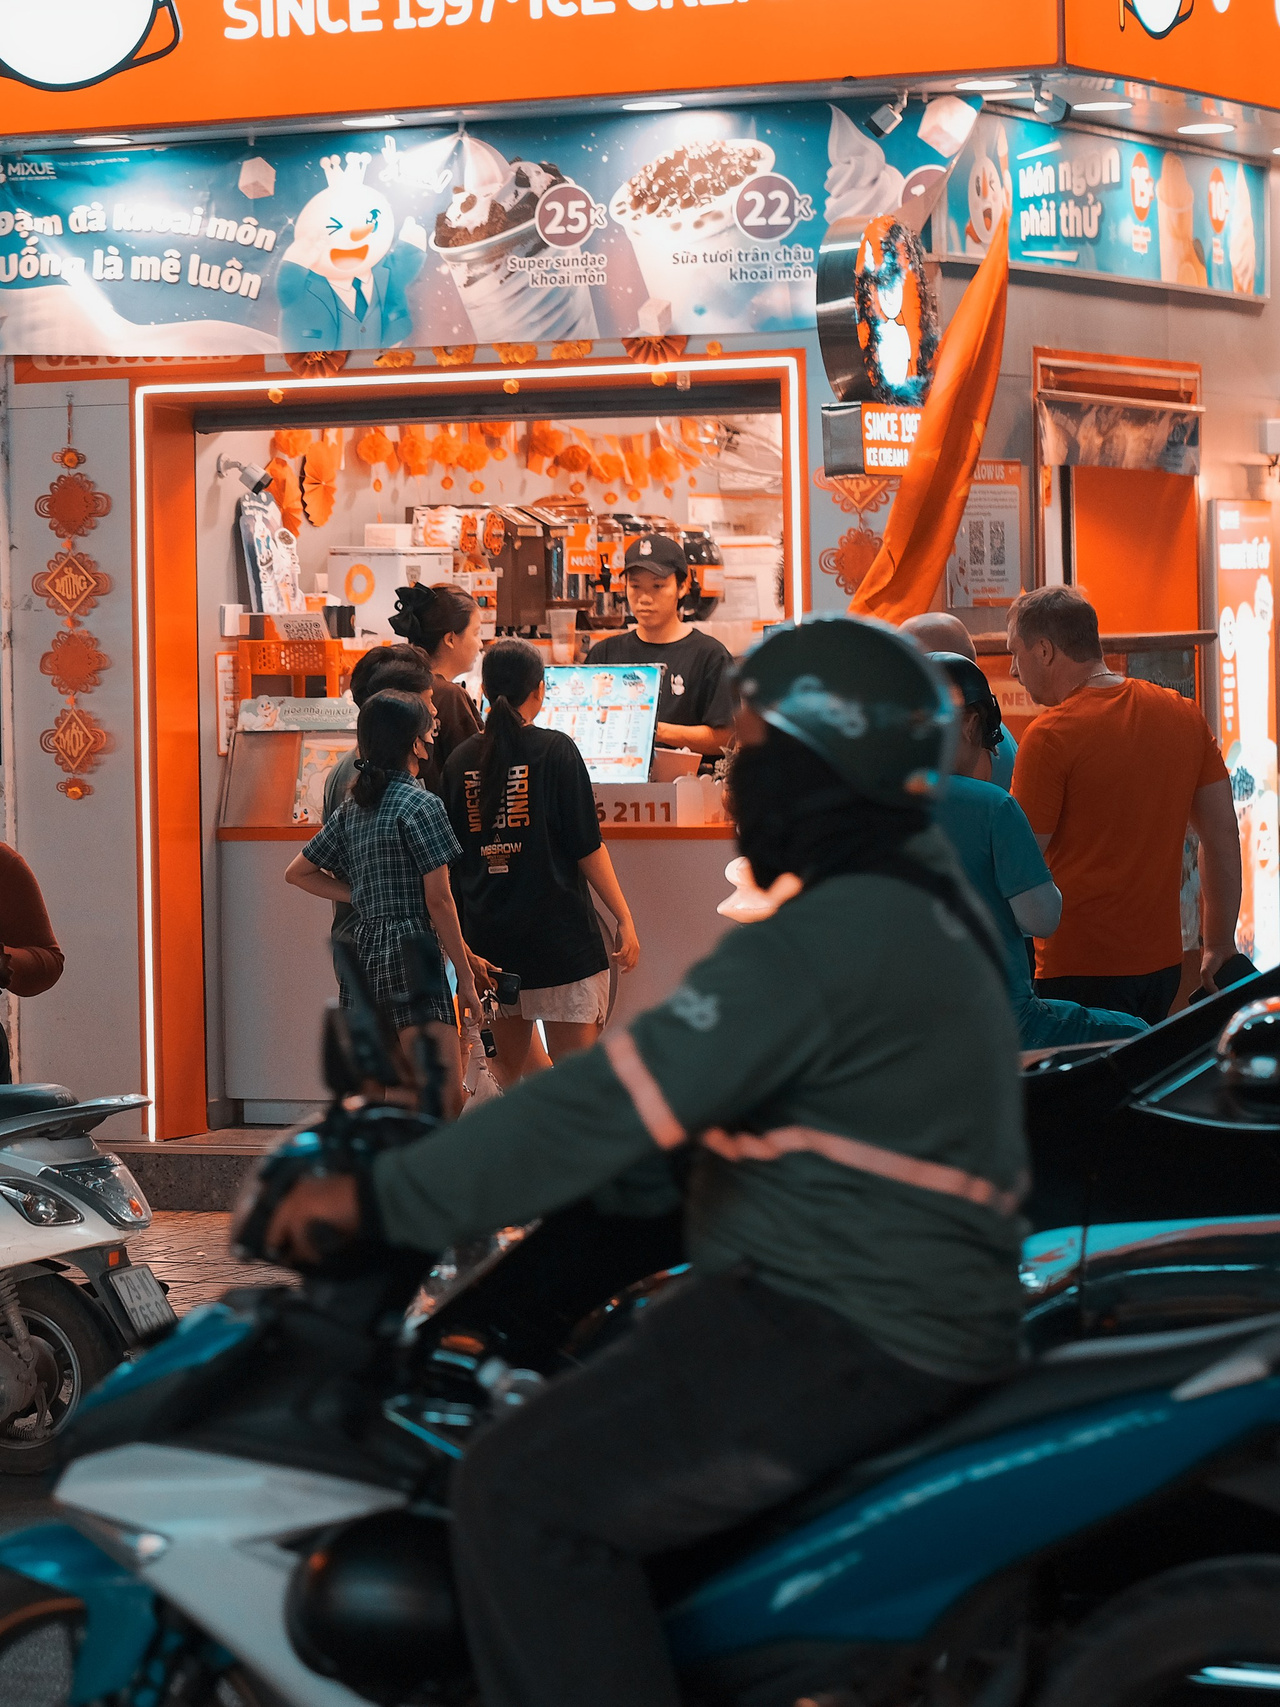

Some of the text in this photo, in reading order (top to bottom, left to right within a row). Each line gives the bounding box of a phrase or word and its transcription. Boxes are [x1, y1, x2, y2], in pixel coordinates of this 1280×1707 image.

[224, 0, 383, 40] SINCE
[7, 162, 56, 176] MIXUE
[1019, 147, 1121, 198] Món ngon
[1020, 193, 1102, 241] phải thử
[206, 216, 277, 252] môn
[508, 254, 606, 272] Super sundae
[702, 248, 734, 264] tươi
[737, 247, 772, 262] trân
[774, 245, 813, 261] châu
[92, 245, 124, 281] là
[130, 248, 182, 284] mê
[187, 253, 263, 300] luôn
[531, 268, 606, 286] khoai môn
[729, 264, 813, 281] khoai môn
[865, 411, 899, 442] SINCE
[506, 764, 531, 829] BRING
[613, 801, 671, 822] 2111
